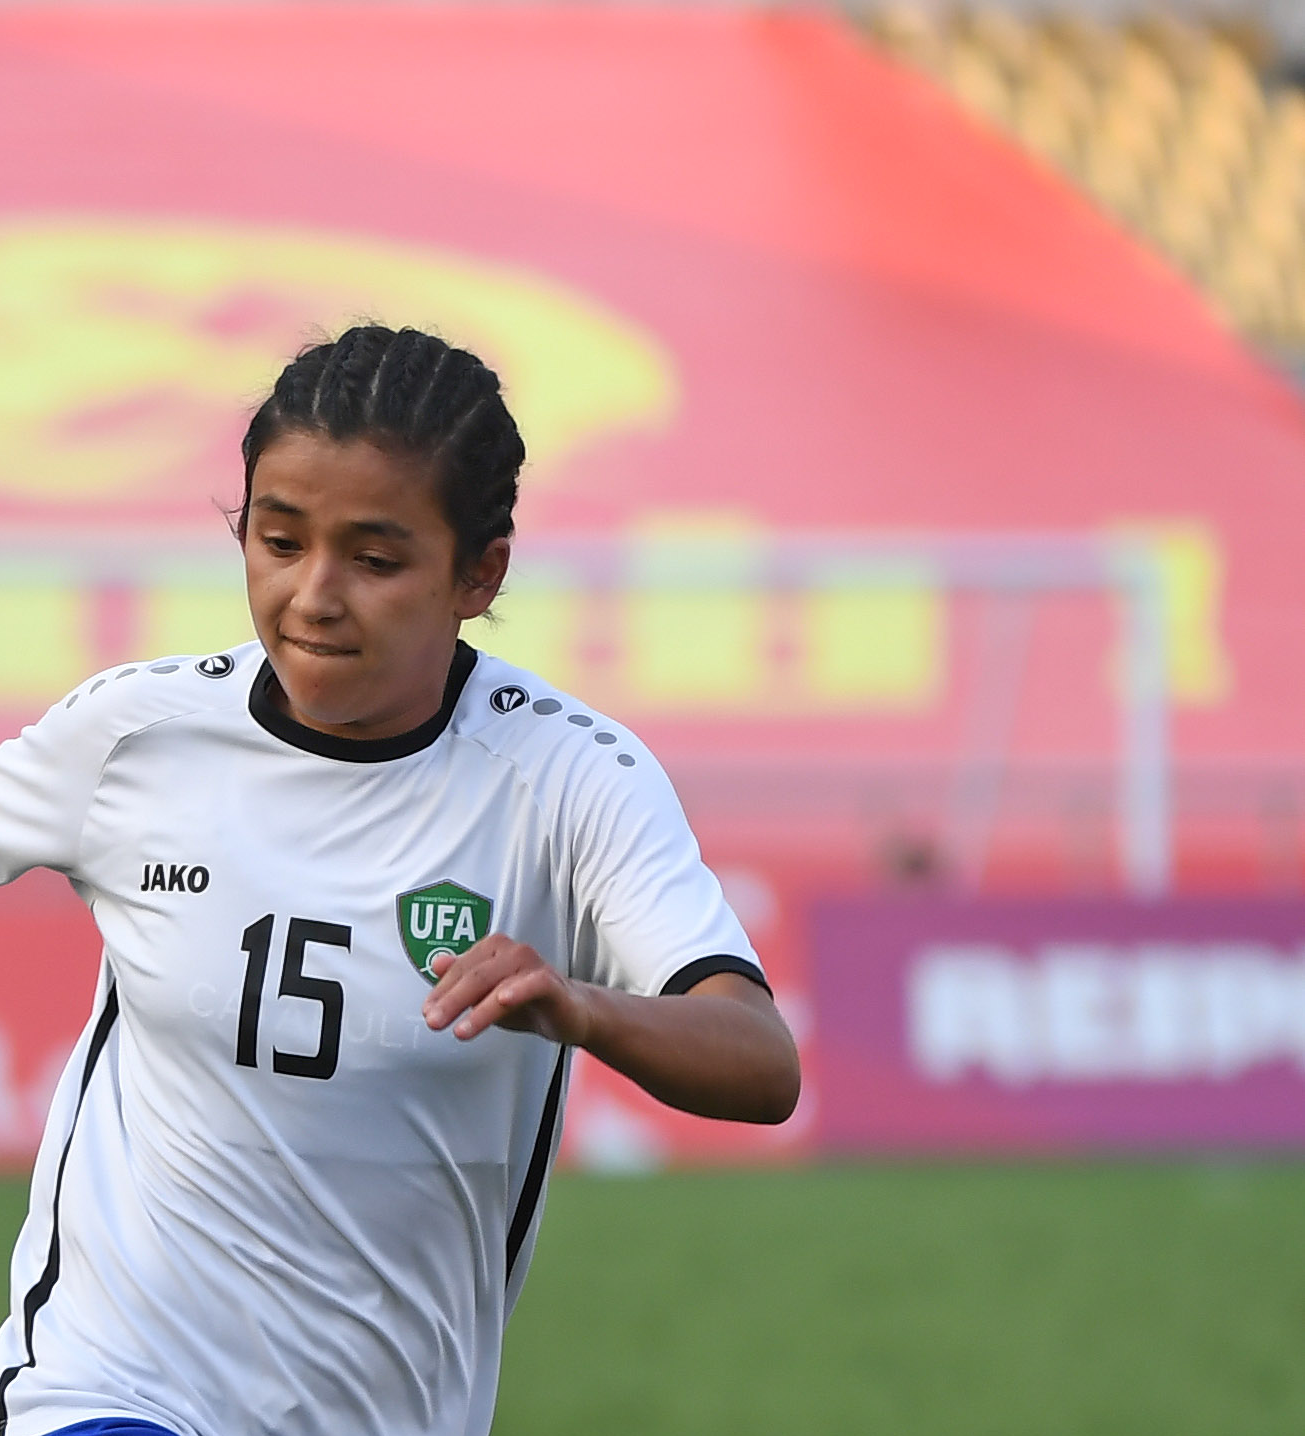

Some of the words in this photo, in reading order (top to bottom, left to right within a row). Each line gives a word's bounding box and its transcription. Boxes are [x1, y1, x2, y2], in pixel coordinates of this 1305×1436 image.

[140, 863, 210, 894] JAKO
[410, 902, 477, 942] UFA
[236, 912, 353, 1081] 15
